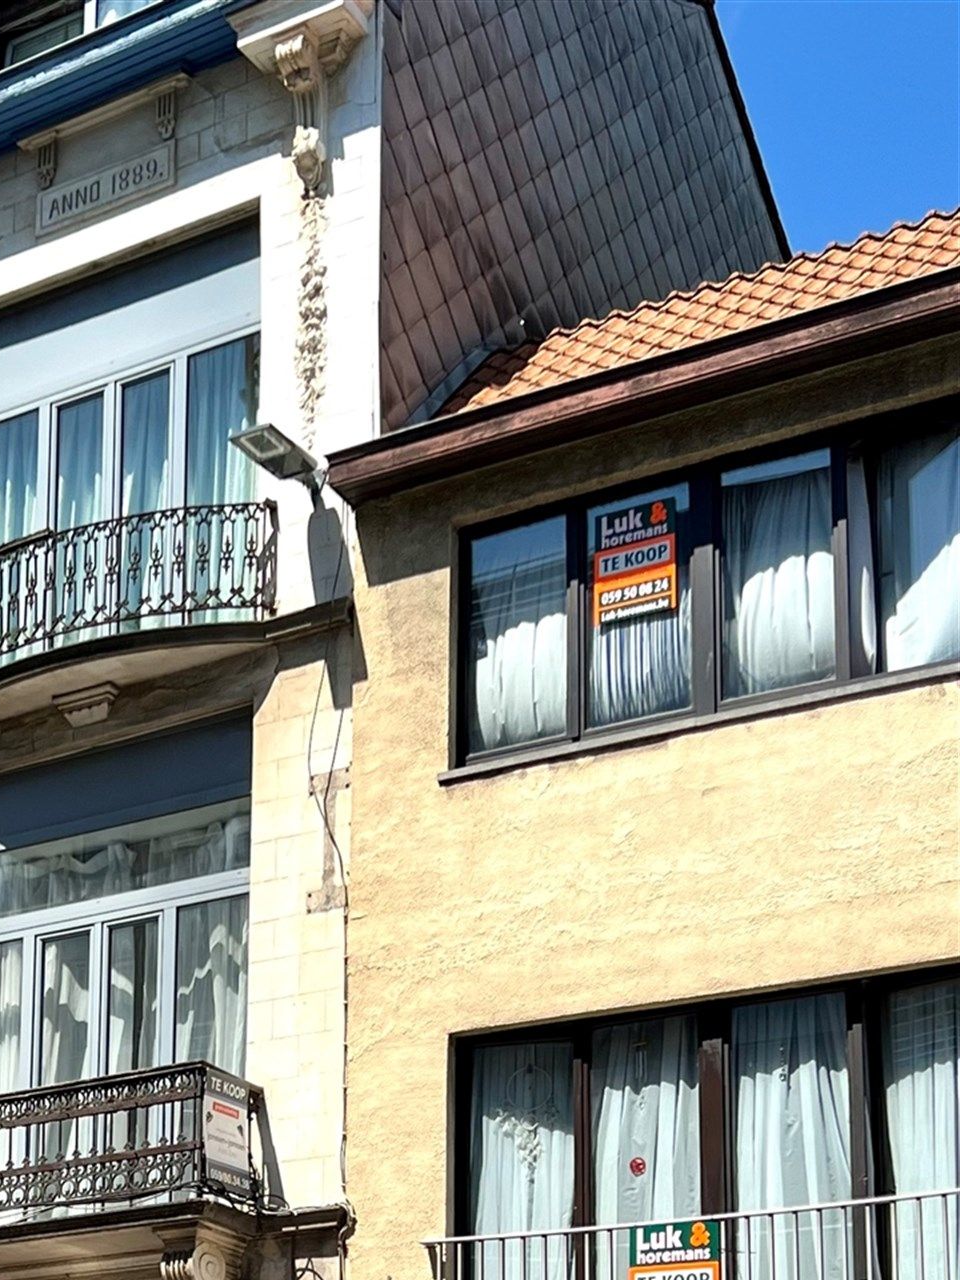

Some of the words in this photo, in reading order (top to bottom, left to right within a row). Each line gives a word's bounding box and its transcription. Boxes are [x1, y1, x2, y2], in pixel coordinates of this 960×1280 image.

[48, 180, 101, 220] ANNO
[601, 509, 643, 536] Luk
[601, 523, 668, 549] horemans
[601, 555, 620, 573] TE
[625, 544, 667, 568] KOOP
[654, 577, 669, 593] 24
[211, 1077, 222, 1092] TE
[223, 1080, 246, 1100] KOOP
[636, 1225, 682, 1251] Luk
[690, 1222, 711, 1247] &
[636, 1247, 711, 1265] horemans
